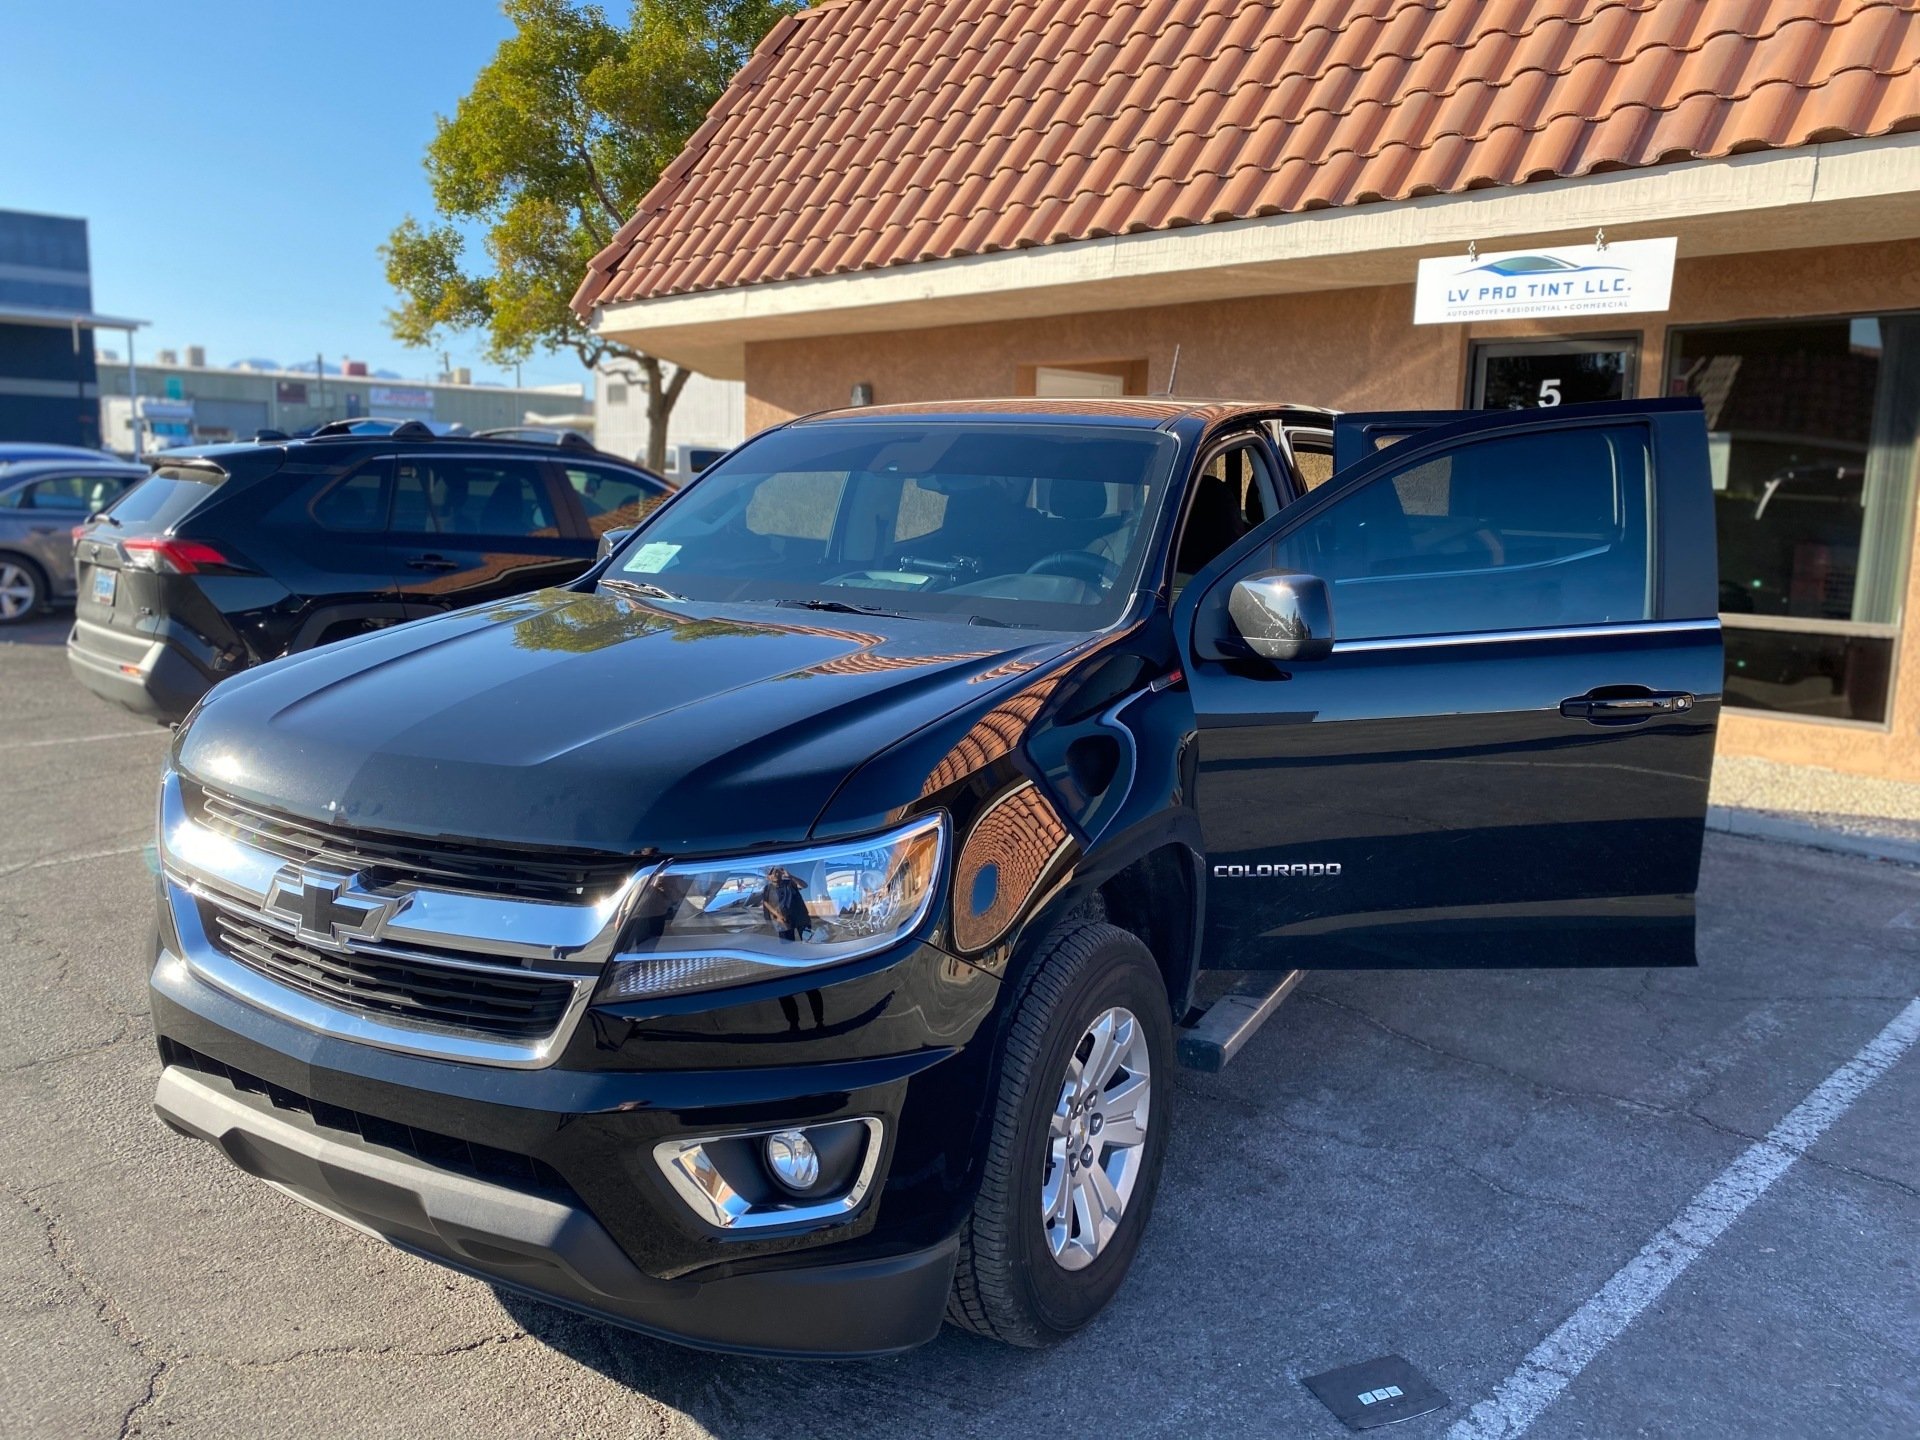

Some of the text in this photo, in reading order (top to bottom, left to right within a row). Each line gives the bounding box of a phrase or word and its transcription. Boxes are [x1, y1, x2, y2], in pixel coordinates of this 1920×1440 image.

[1447, 277, 1632, 303] LV PRO TINT LLC.
[1446, 300, 1629, 318] AUTOMOTIVE RESIDENTIAL COMMERCIAL
[1537, 378, 1562, 408] 5
[1213, 863, 1342, 878] COLORADO
